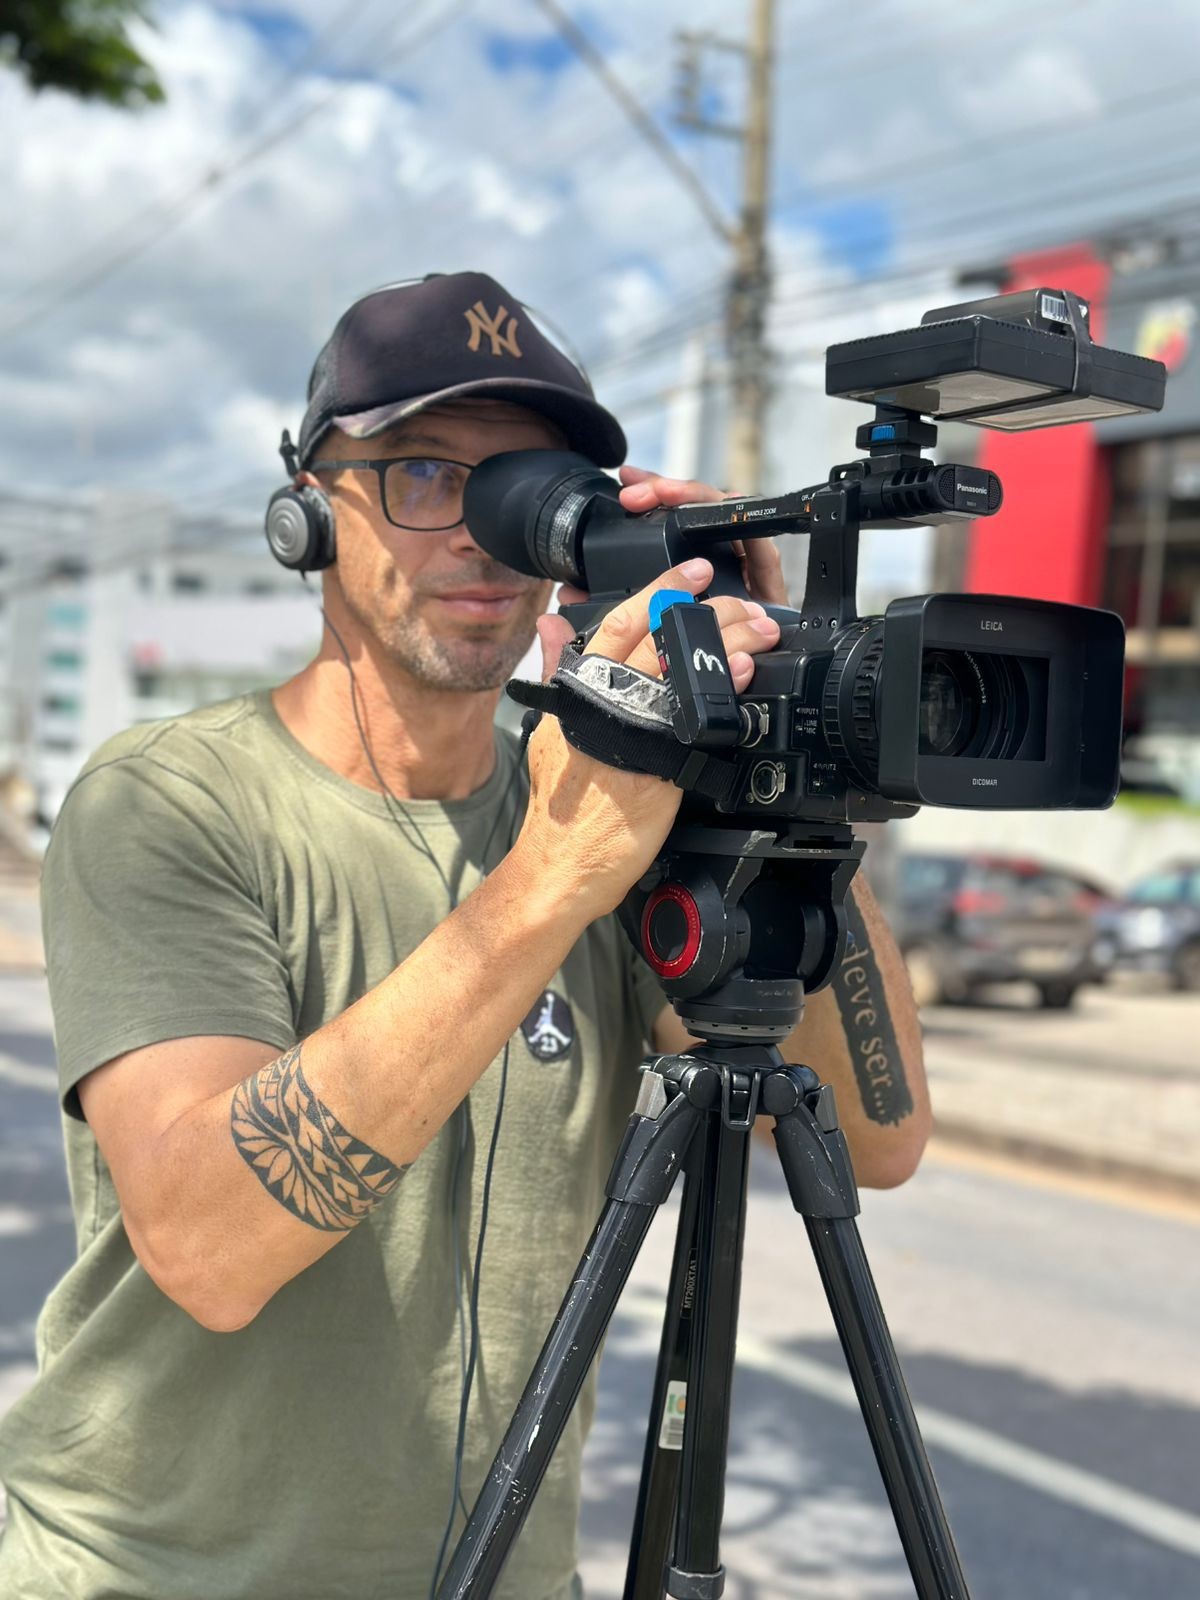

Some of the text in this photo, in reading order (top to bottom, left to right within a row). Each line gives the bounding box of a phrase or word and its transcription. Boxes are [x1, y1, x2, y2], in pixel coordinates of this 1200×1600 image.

[463, 300, 523, 358] NY
[956, 483, 988, 495] Panasonic
[764, 507, 777, 515] ZOOM
[980, 619, 1003, 631] LEICA
[972, 778, 998, 786] DICOMAR
